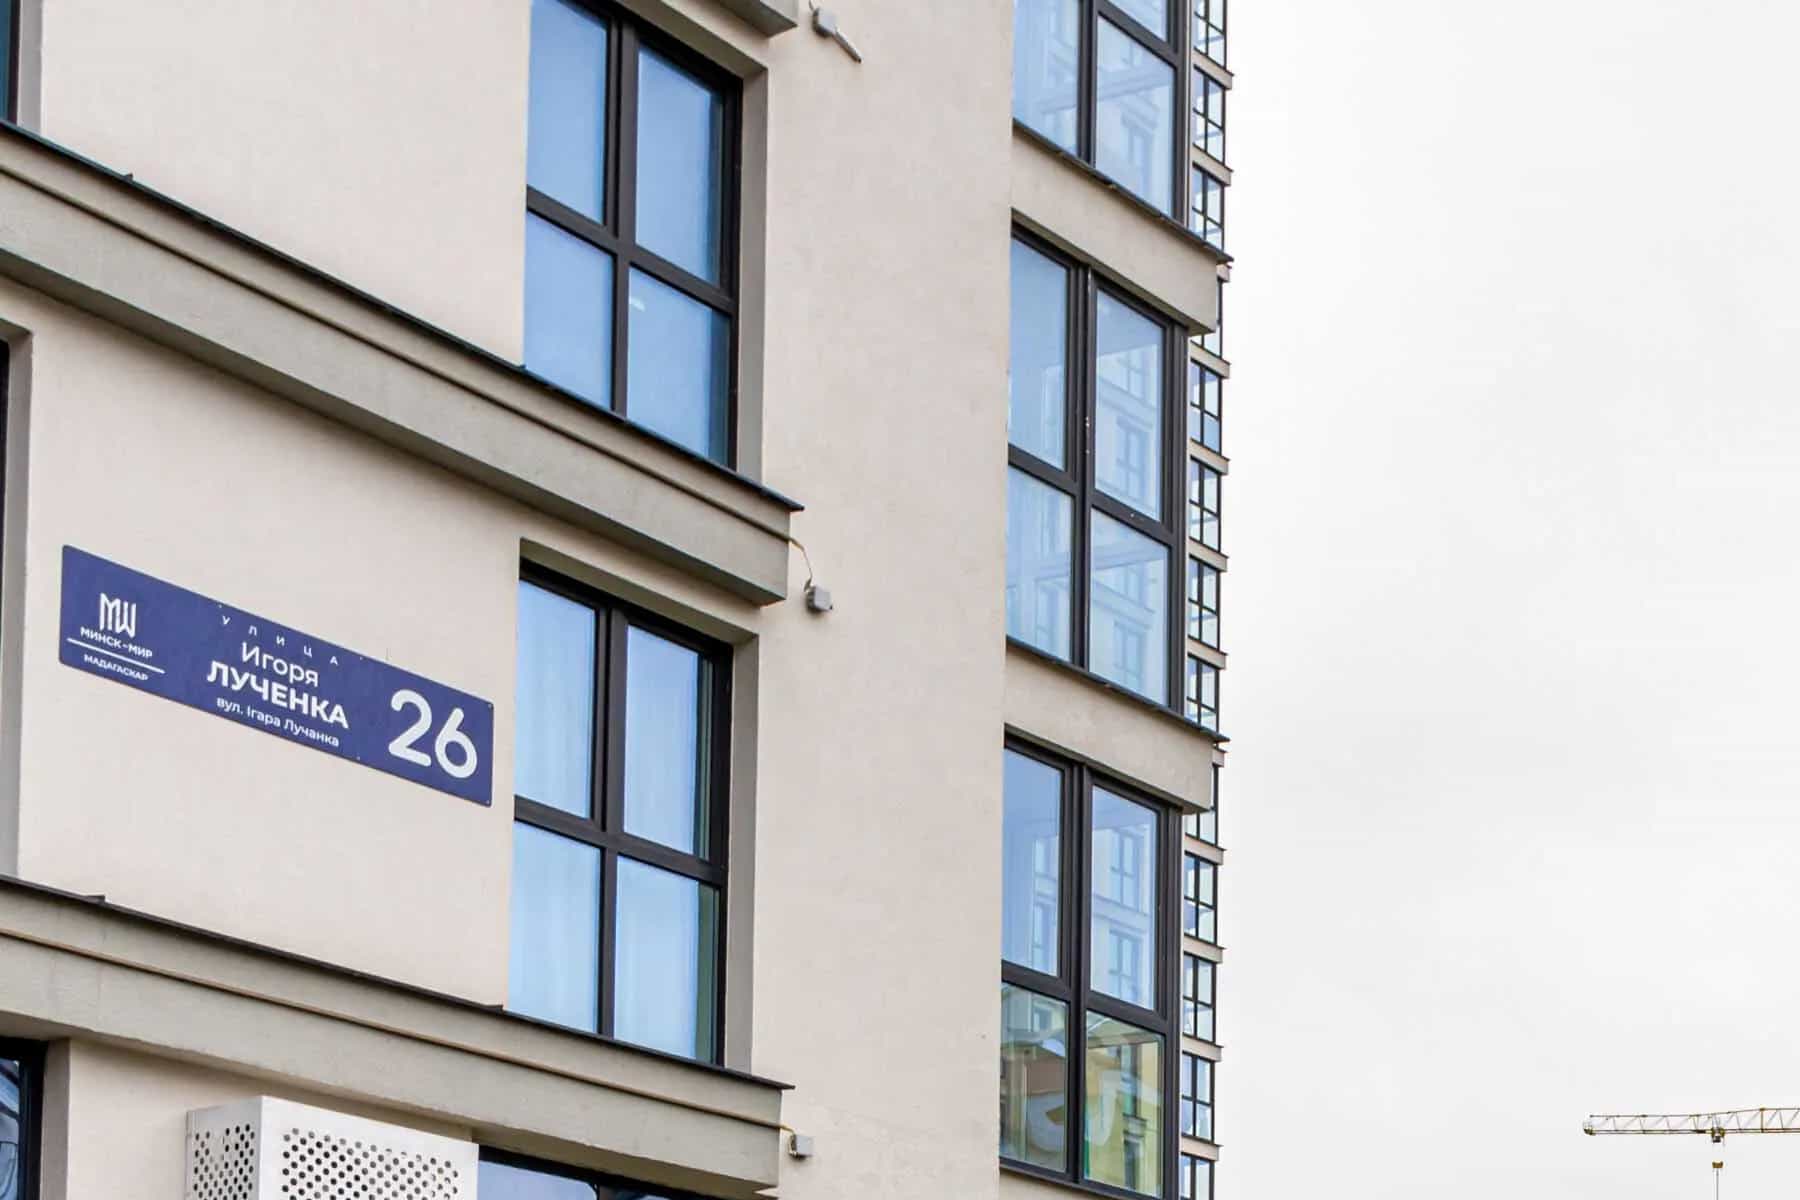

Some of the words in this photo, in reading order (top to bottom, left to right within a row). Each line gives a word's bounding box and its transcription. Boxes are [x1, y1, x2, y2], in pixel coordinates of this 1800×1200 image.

[80, 626, 153, 658] МИНСК-МИР
[241, 641, 319, 688] Игоря
[83, 653, 149, 681] МАДАГАСКАР
[206, 660, 349, 729] ЛУЧЕНКА
[216, 697, 244, 716] вул.
[247, 705, 281, 727] Ігара
[283, 718, 340, 747] Лучанка
[388, 688, 478, 779] 26
